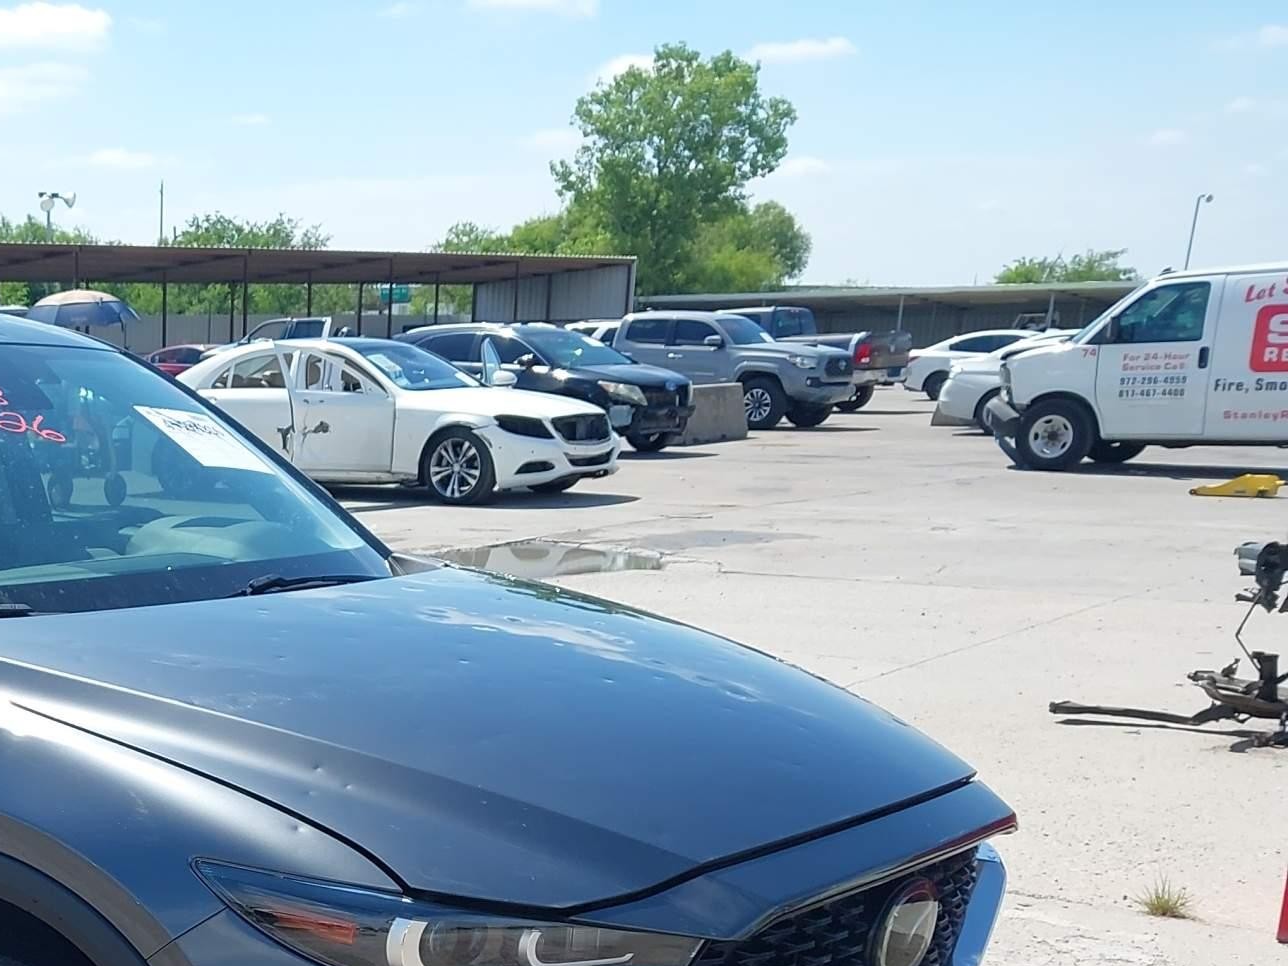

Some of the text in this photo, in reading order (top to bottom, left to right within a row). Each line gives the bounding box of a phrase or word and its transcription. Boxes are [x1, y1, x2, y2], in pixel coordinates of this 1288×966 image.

[1245, 283, 1276, 302] Let
[1082, 348, 1096, 357] 74
[1123, 352, 1190, 361] For 24-Hour
[1122, 363, 1161, 371] Service
[1214, 378, 1250, 393] Fire,
